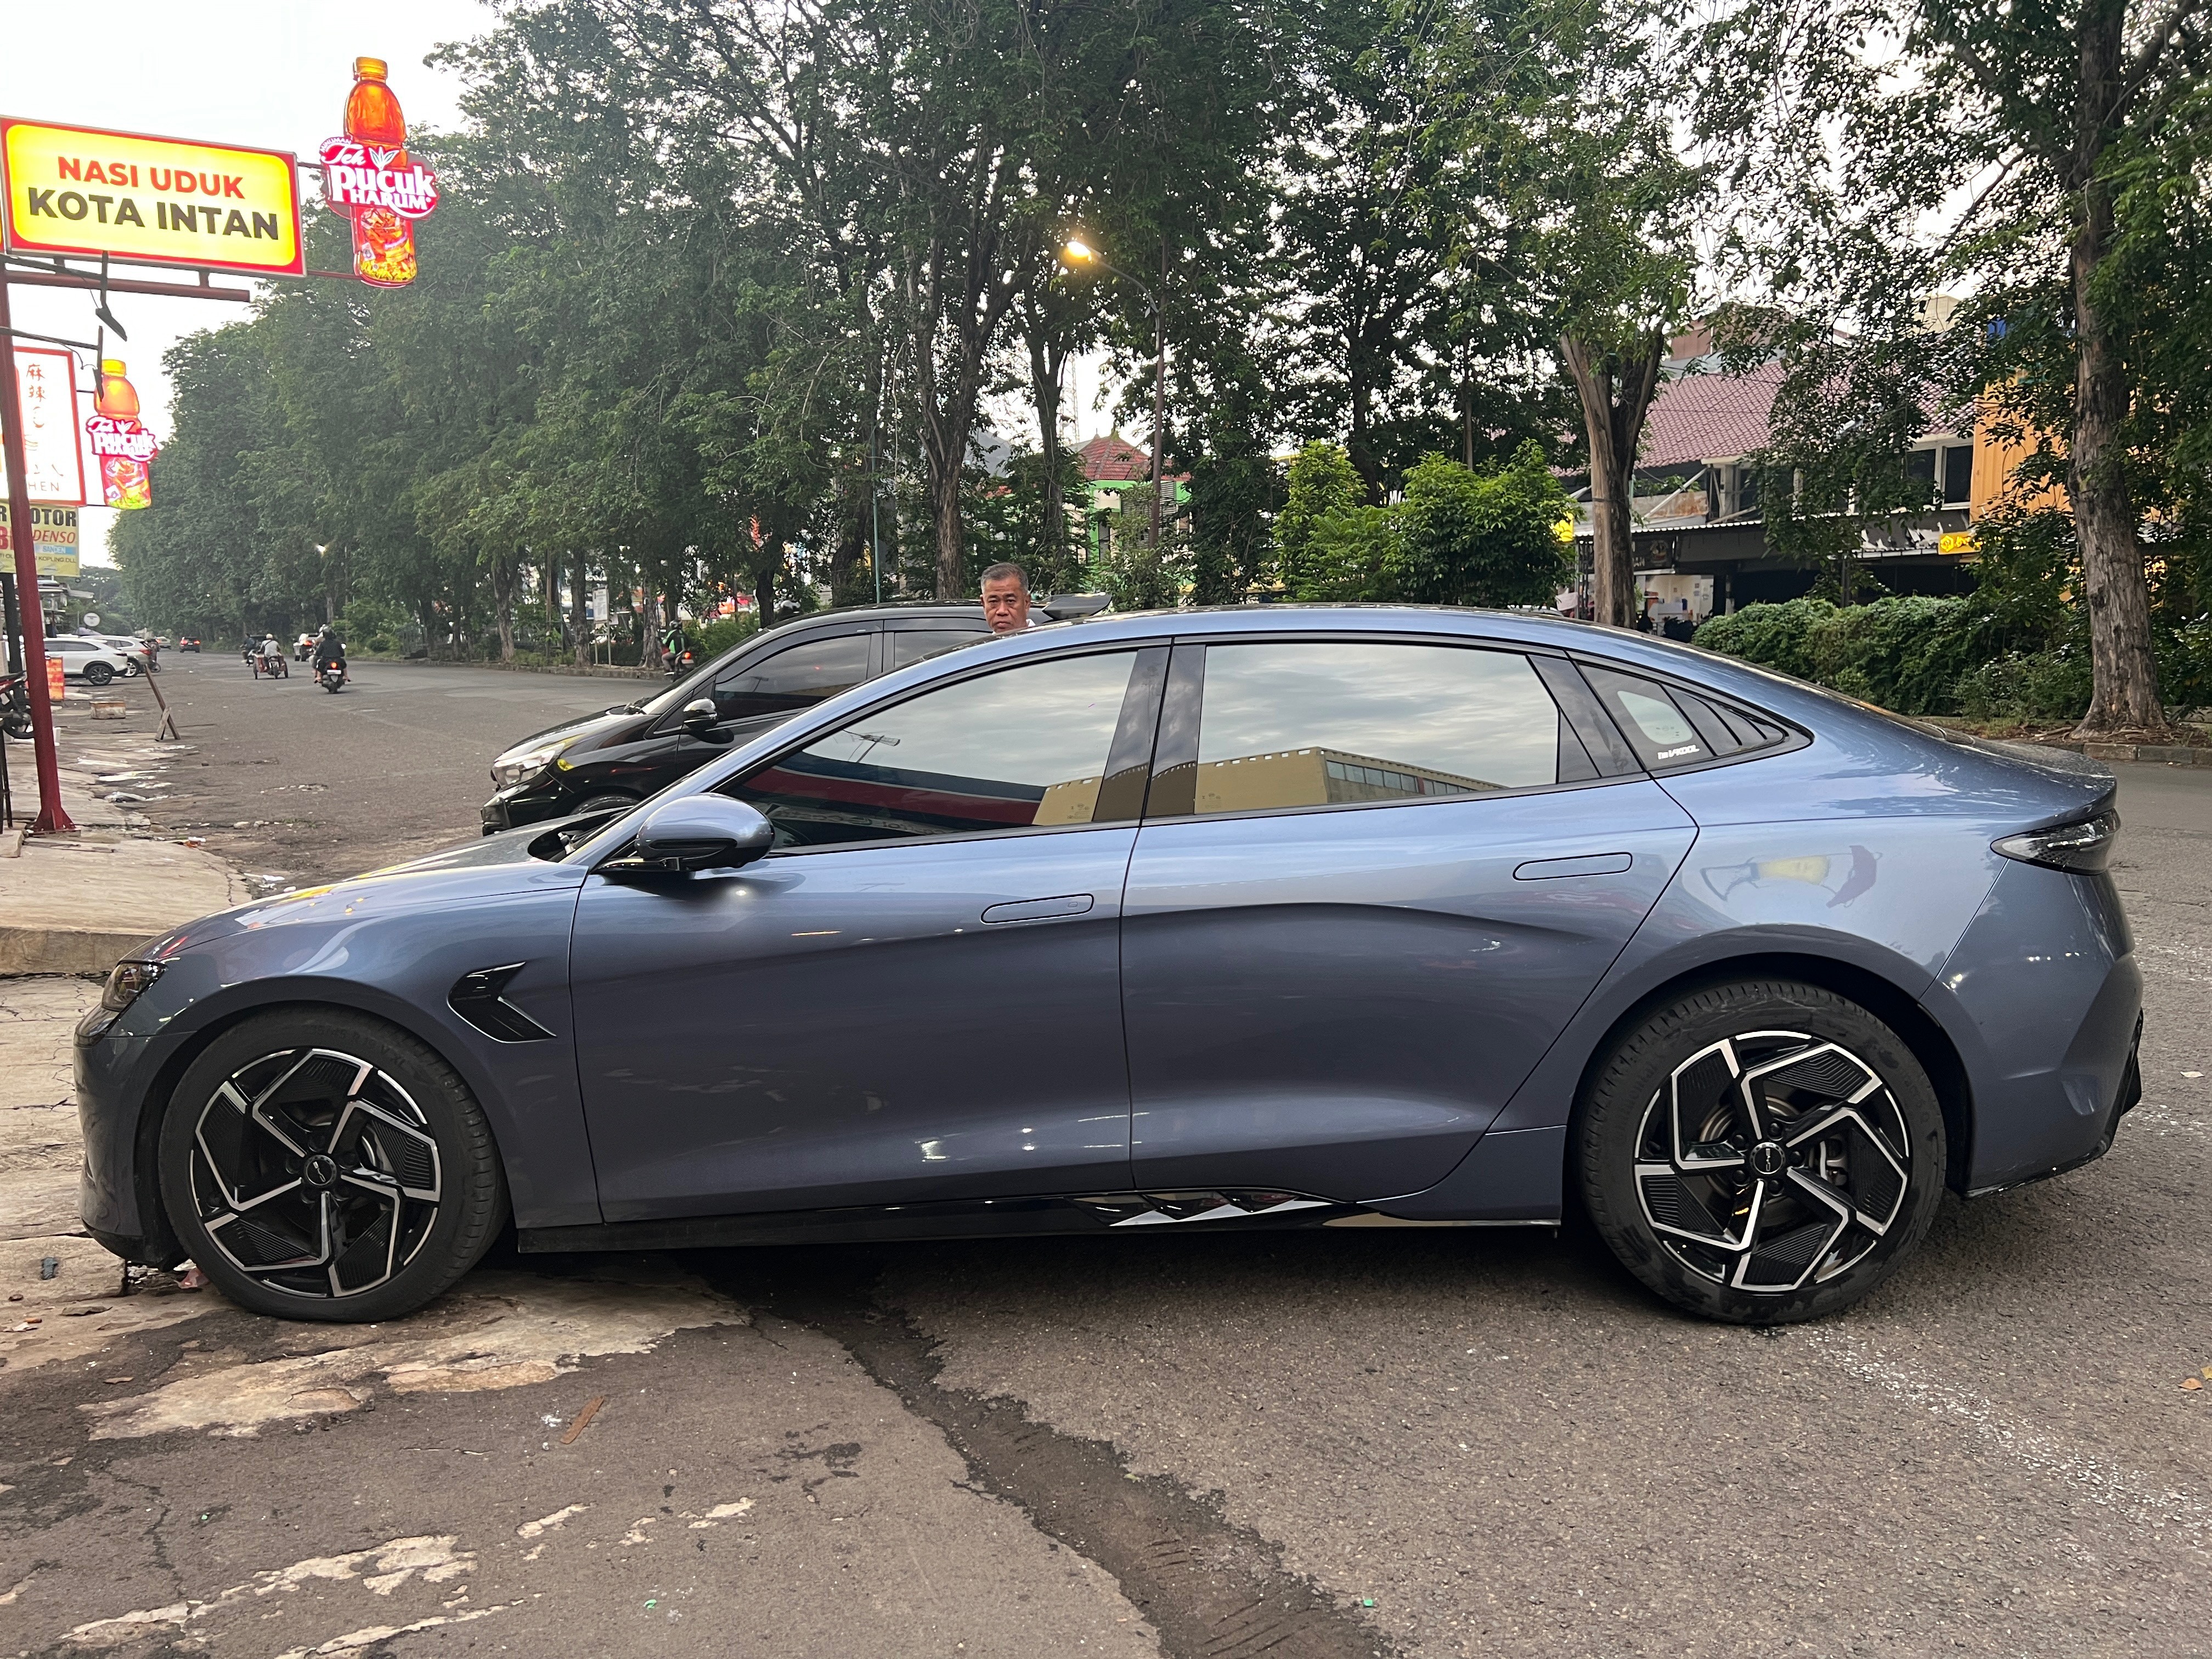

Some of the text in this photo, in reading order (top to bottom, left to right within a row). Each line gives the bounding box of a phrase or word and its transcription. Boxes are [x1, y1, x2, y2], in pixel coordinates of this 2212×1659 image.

[321, 143, 366, 165] Teh
[58, 156, 245, 200] NASI UDUK
[29, 187, 278, 240] KOTA INTAN
[29, 481, 59, 492] HEN
[31, 507, 76, 527] OTOR
[33, 529, 76, 544] DENSO
